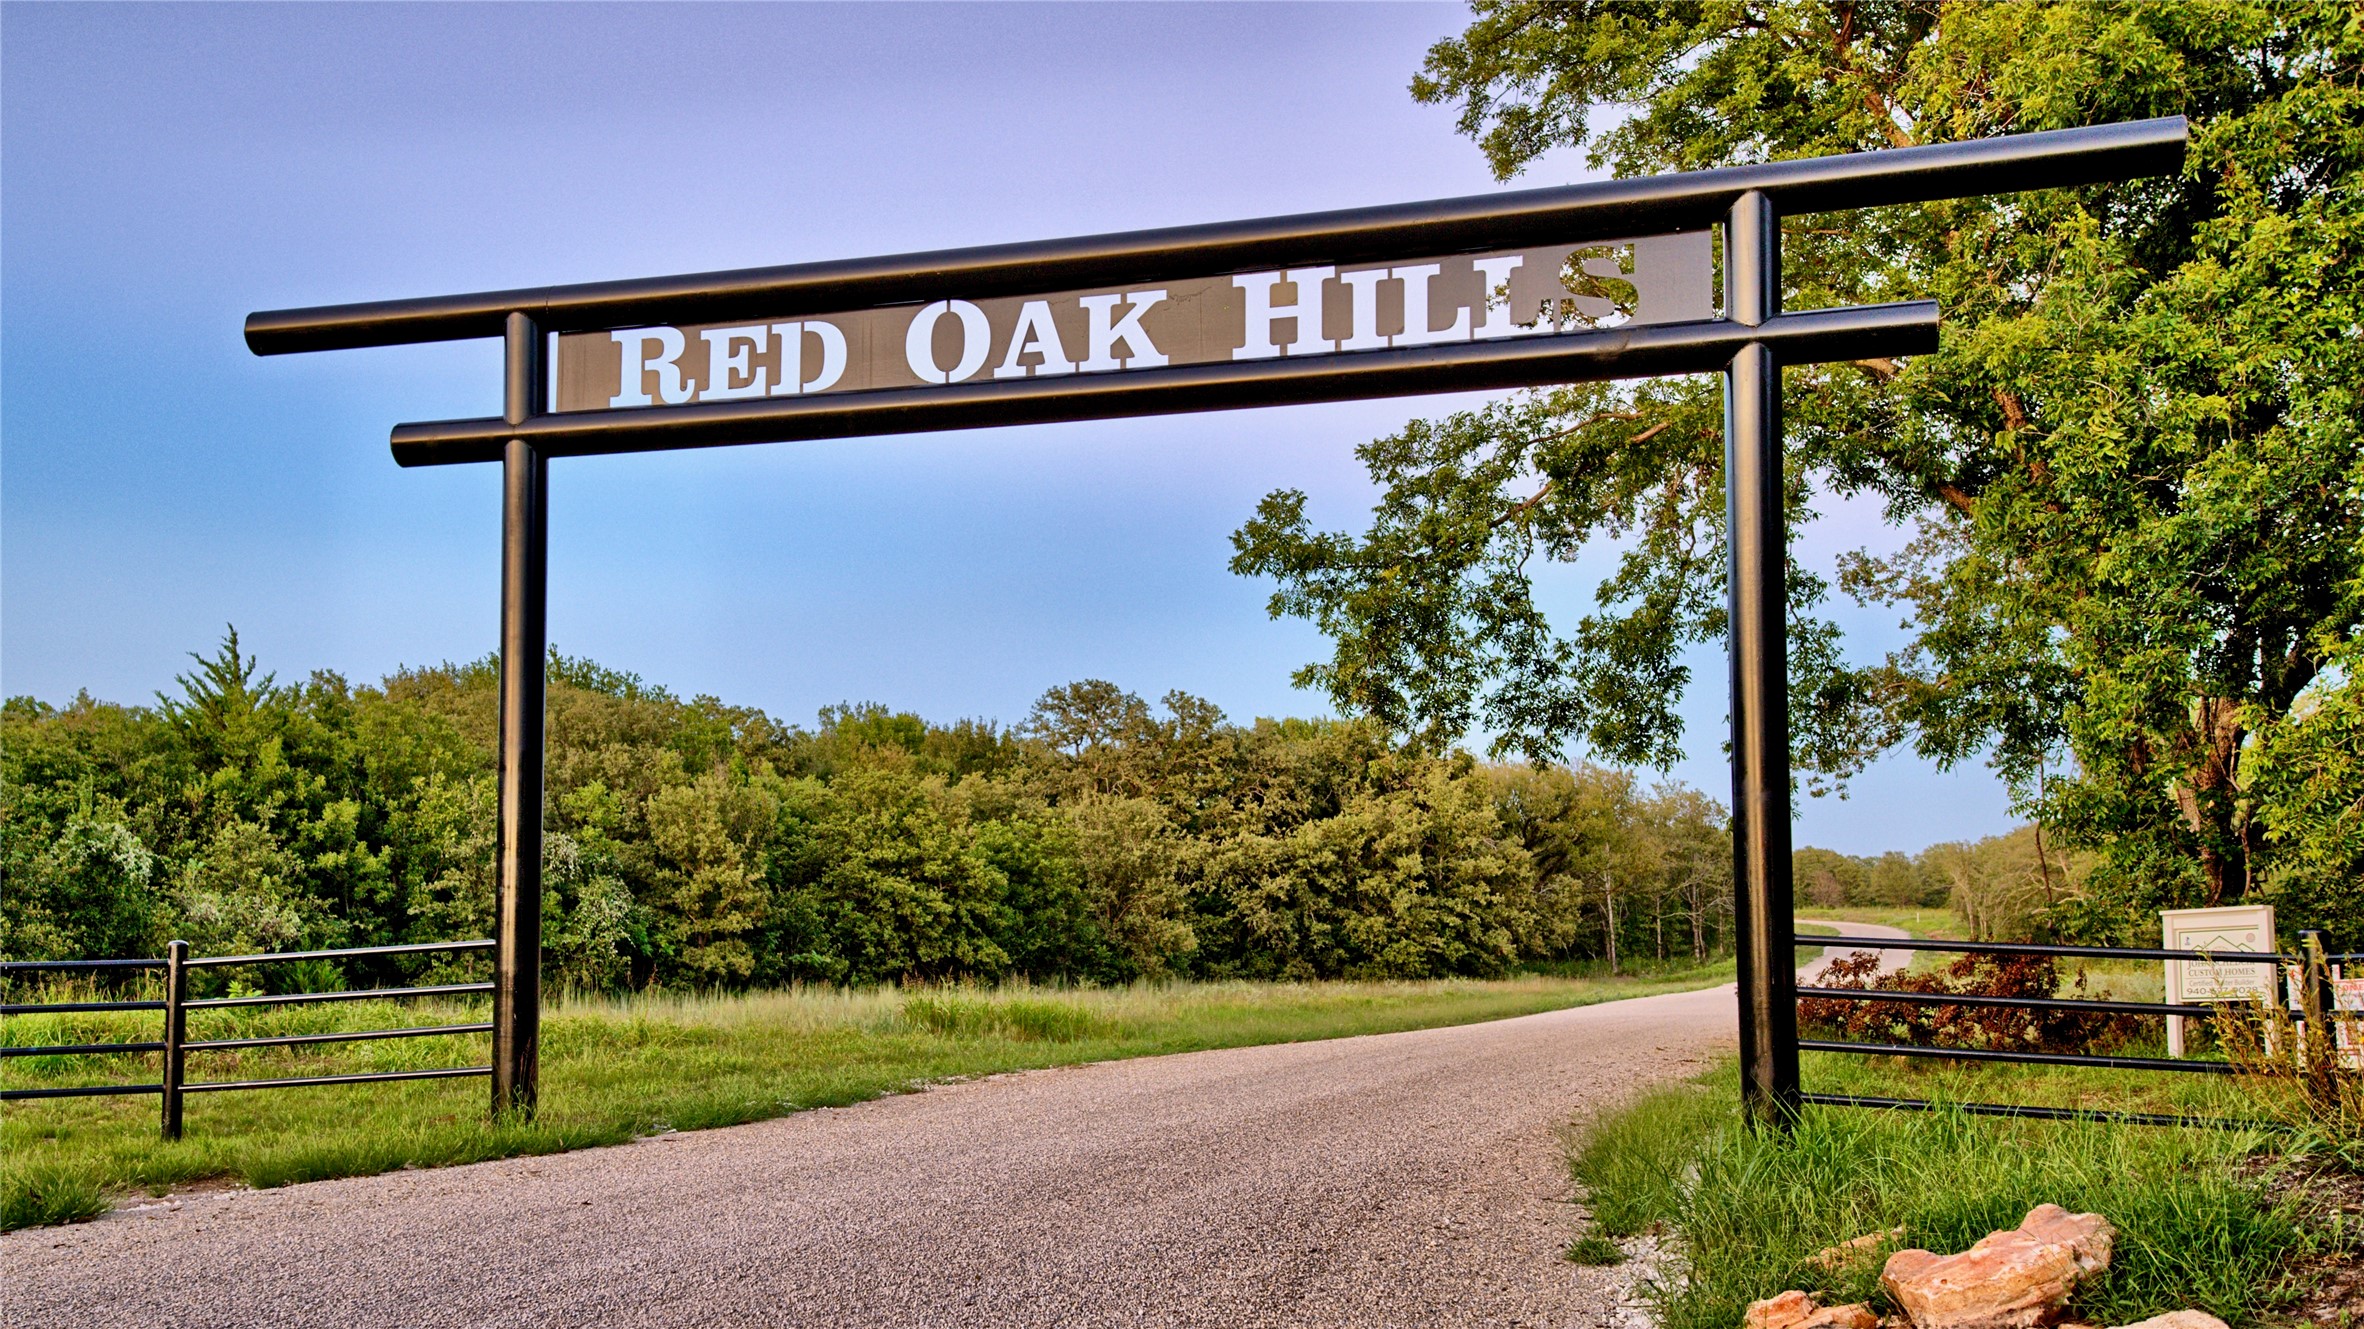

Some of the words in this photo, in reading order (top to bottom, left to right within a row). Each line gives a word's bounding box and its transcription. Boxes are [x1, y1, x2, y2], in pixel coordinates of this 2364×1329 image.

[609, 320, 848, 408] RED
[905, 289, 1169, 384] OAK
[1232, 243, 1640, 361] HILLS
[2188, 969, 2223, 977] CUSTOM
[2224, 967, 2256, 976] HOMES
